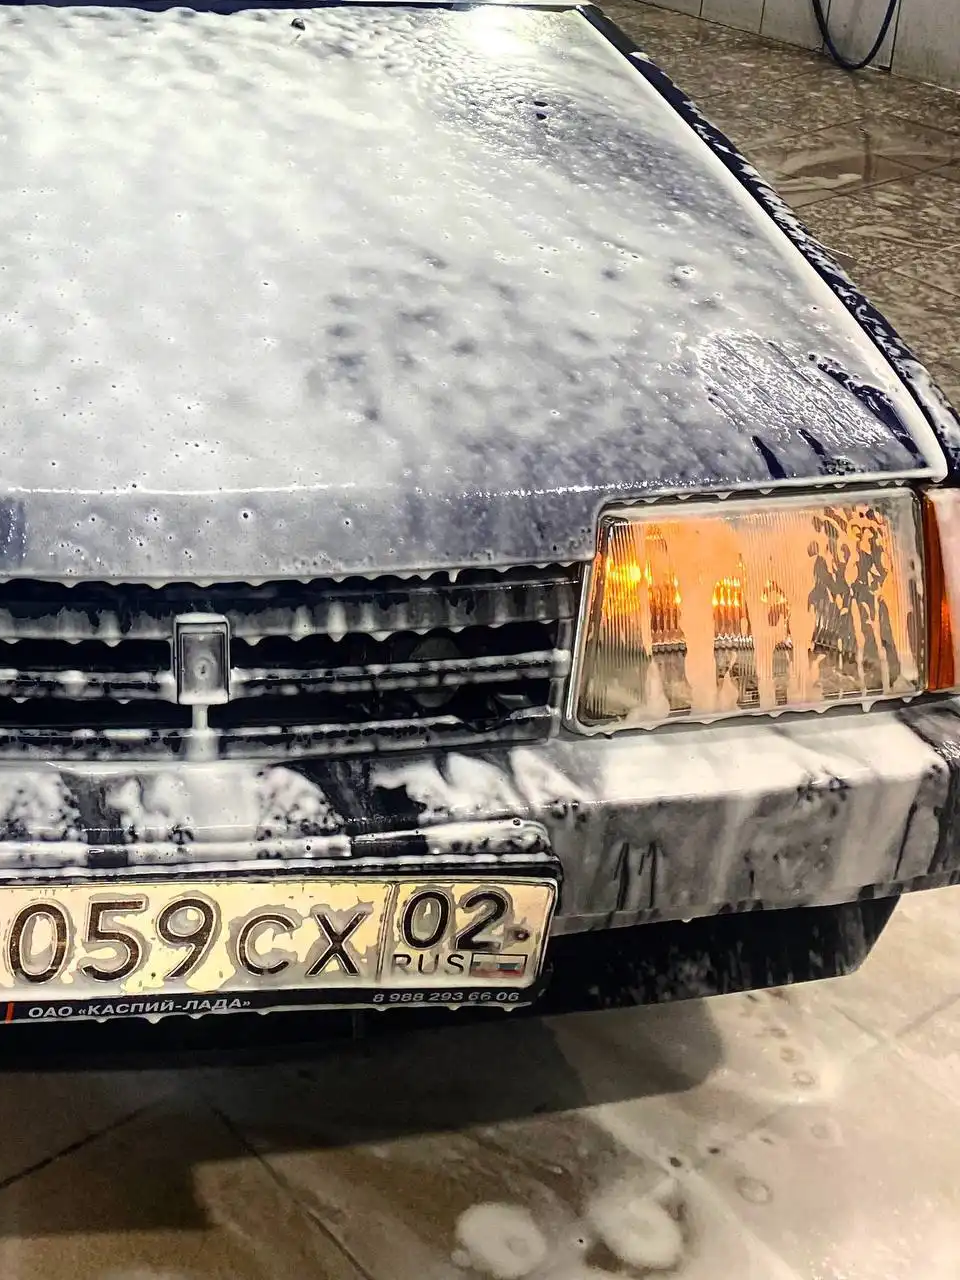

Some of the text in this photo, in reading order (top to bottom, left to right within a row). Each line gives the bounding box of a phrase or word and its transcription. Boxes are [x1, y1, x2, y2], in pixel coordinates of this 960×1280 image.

[401, 890, 510, 951] 02
[7, 897, 217, 985] 059
[236, 911, 367, 977] СХ
[392, 953, 465, 976] RUS
[28, 997, 251, 1019] ОАО «КАСПИЙ-ЛАДА»
[372, 991, 520, 1003] 8 988 293 66 06
